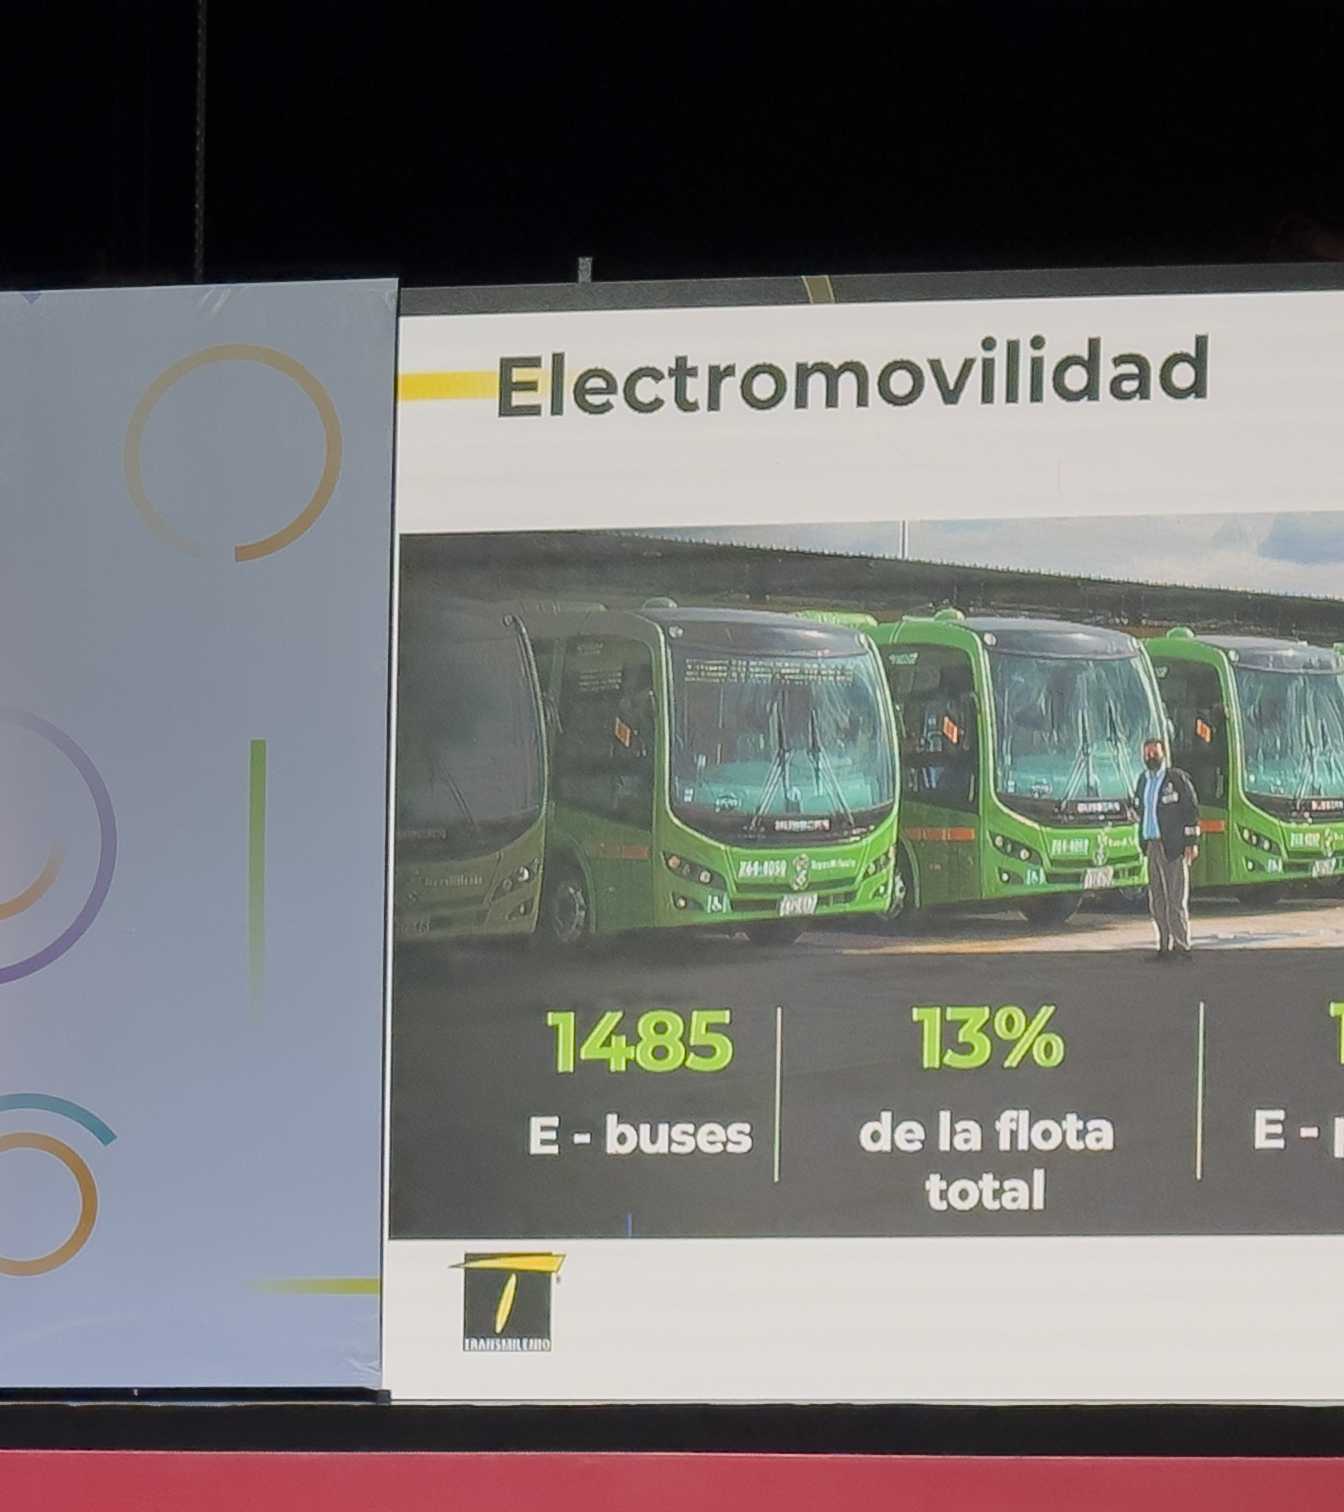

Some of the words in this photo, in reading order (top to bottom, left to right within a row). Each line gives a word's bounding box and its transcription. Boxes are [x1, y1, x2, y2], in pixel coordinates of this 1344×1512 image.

[497, 334, 1208, 418] Electromovilidad
[547, 1007, 733, 1074] 1485
[912, 1003, 1065, 1070] 13%
[529, 1116, 560, 1155] E
[605, 1112, 753, 1155] buses
[859, 1111, 924, 1153] de
[939, 1111, 982, 1153] la
[996, 1108, 1114, 1152] flota
[1254, 1109, 1285, 1149] E
[927, 1168, 1045, 1211] total
[464, 1338, 551, 1351] TRANSMILENIO
